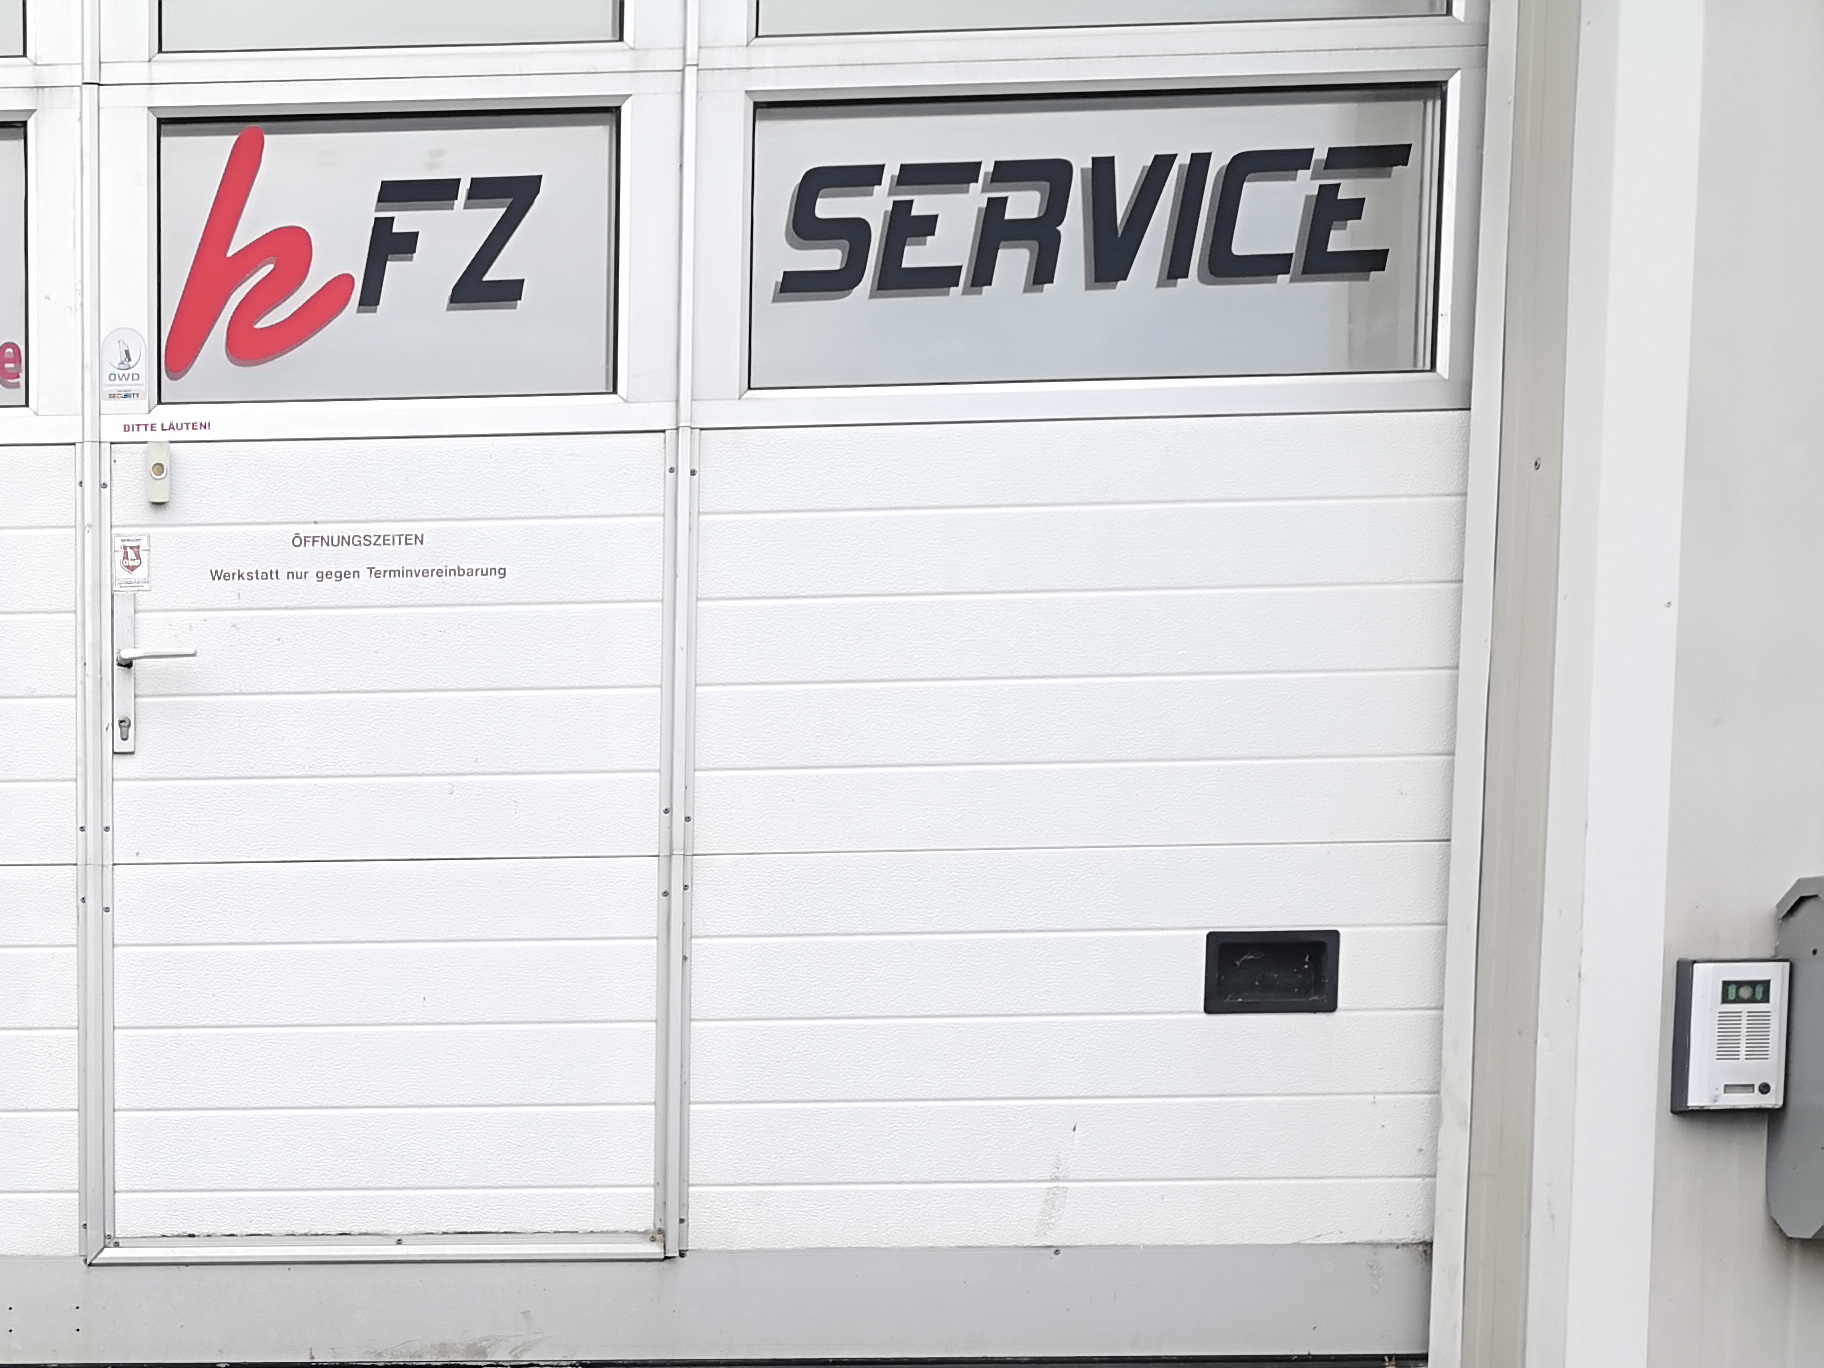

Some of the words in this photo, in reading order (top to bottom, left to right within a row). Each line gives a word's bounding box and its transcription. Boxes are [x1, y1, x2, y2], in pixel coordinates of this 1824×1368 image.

[778, 143, 1413, 294] SERVICE
[123, 423, 157, 433] BITTE
[161, 420, 211, 431] LÄUTEN!
[291, 533, 425, 548] ÖFFNUNGSZEITEN
[209, 568, 279, 581] Werkstatt
[286, 570, 308, 580] nur
[315, 569, 361, 582] gegen
[366, 566, 507, 580] Terminvereinbarung
